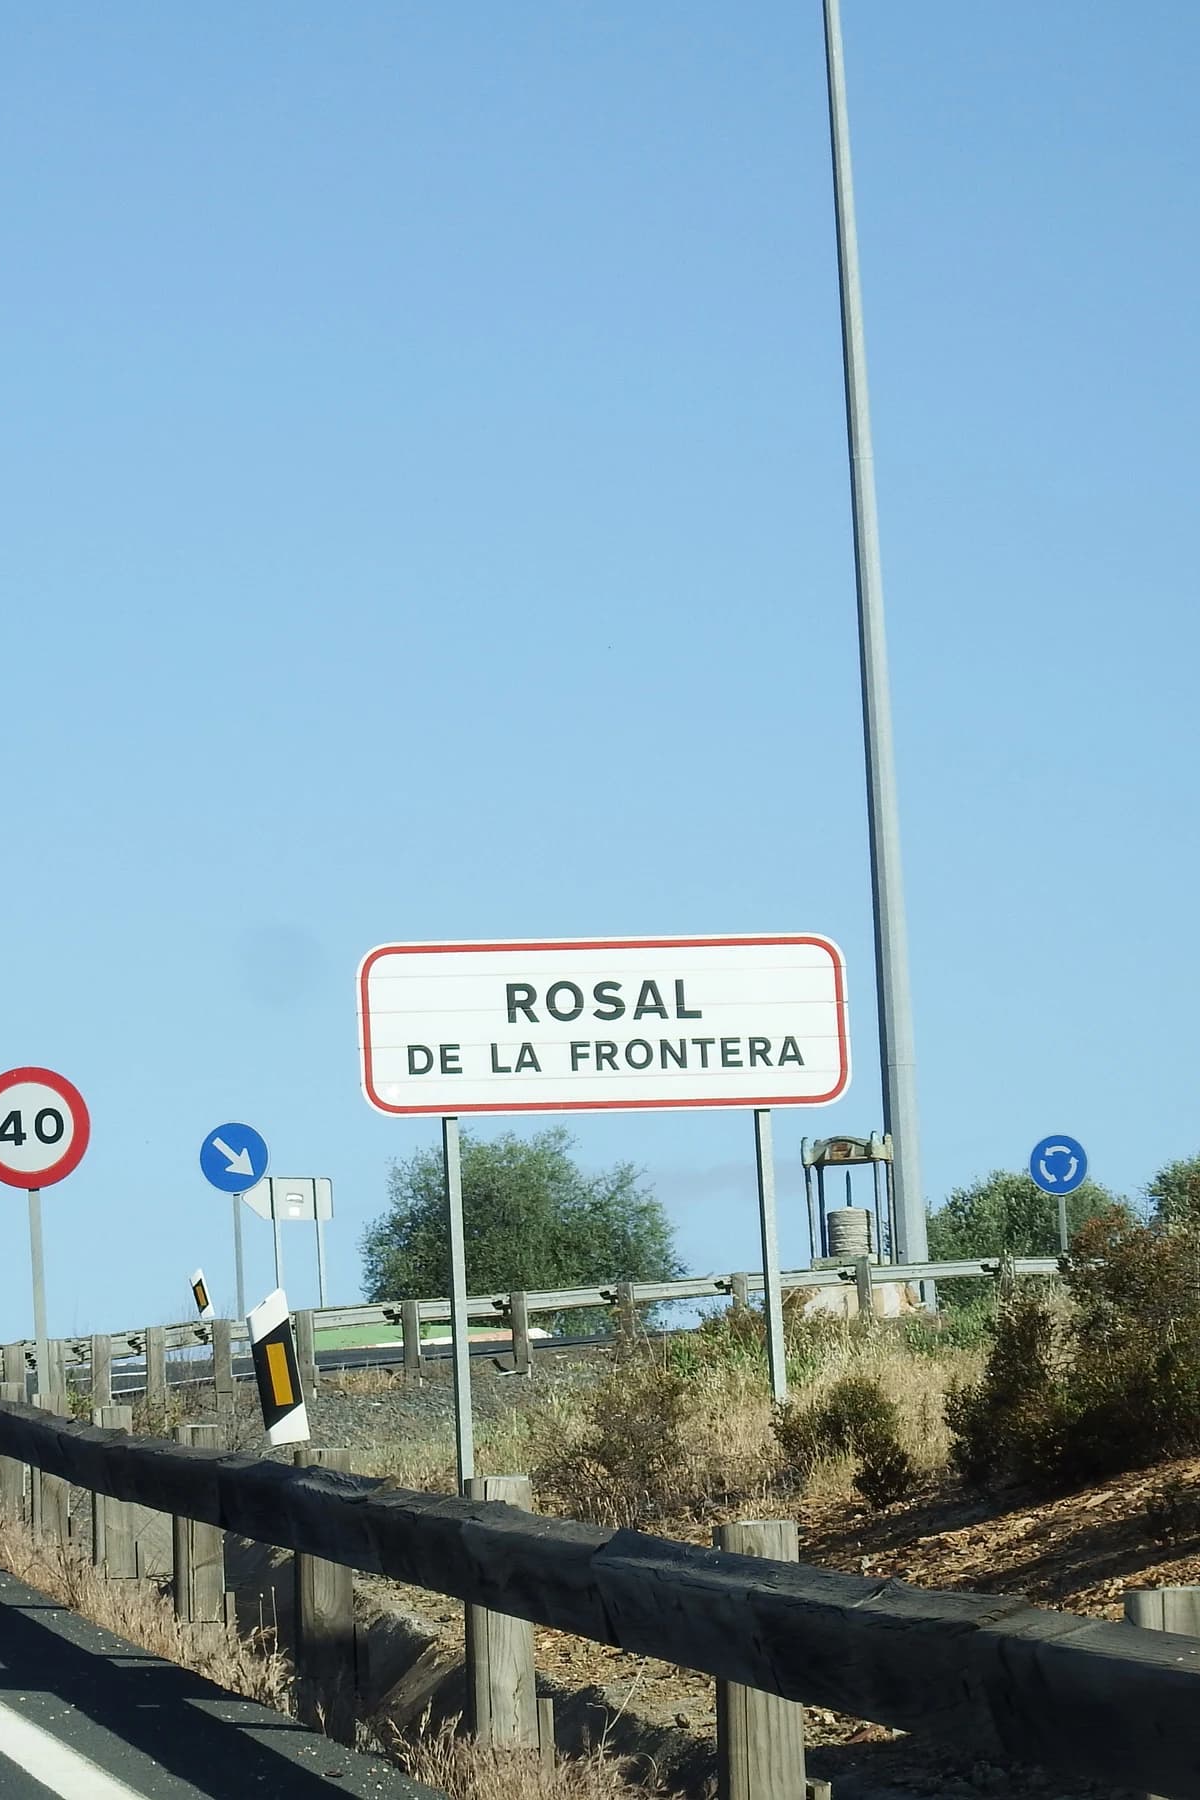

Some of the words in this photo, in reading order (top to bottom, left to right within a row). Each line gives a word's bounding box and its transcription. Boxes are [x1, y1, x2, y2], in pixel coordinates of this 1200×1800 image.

[505, 979, 702, 1024] ROSAL
[407, 1044, 463, 1075] DE
[490, 1042, 542, 1073] LA
[570, 1035, 806, 1072] FRONTERA
